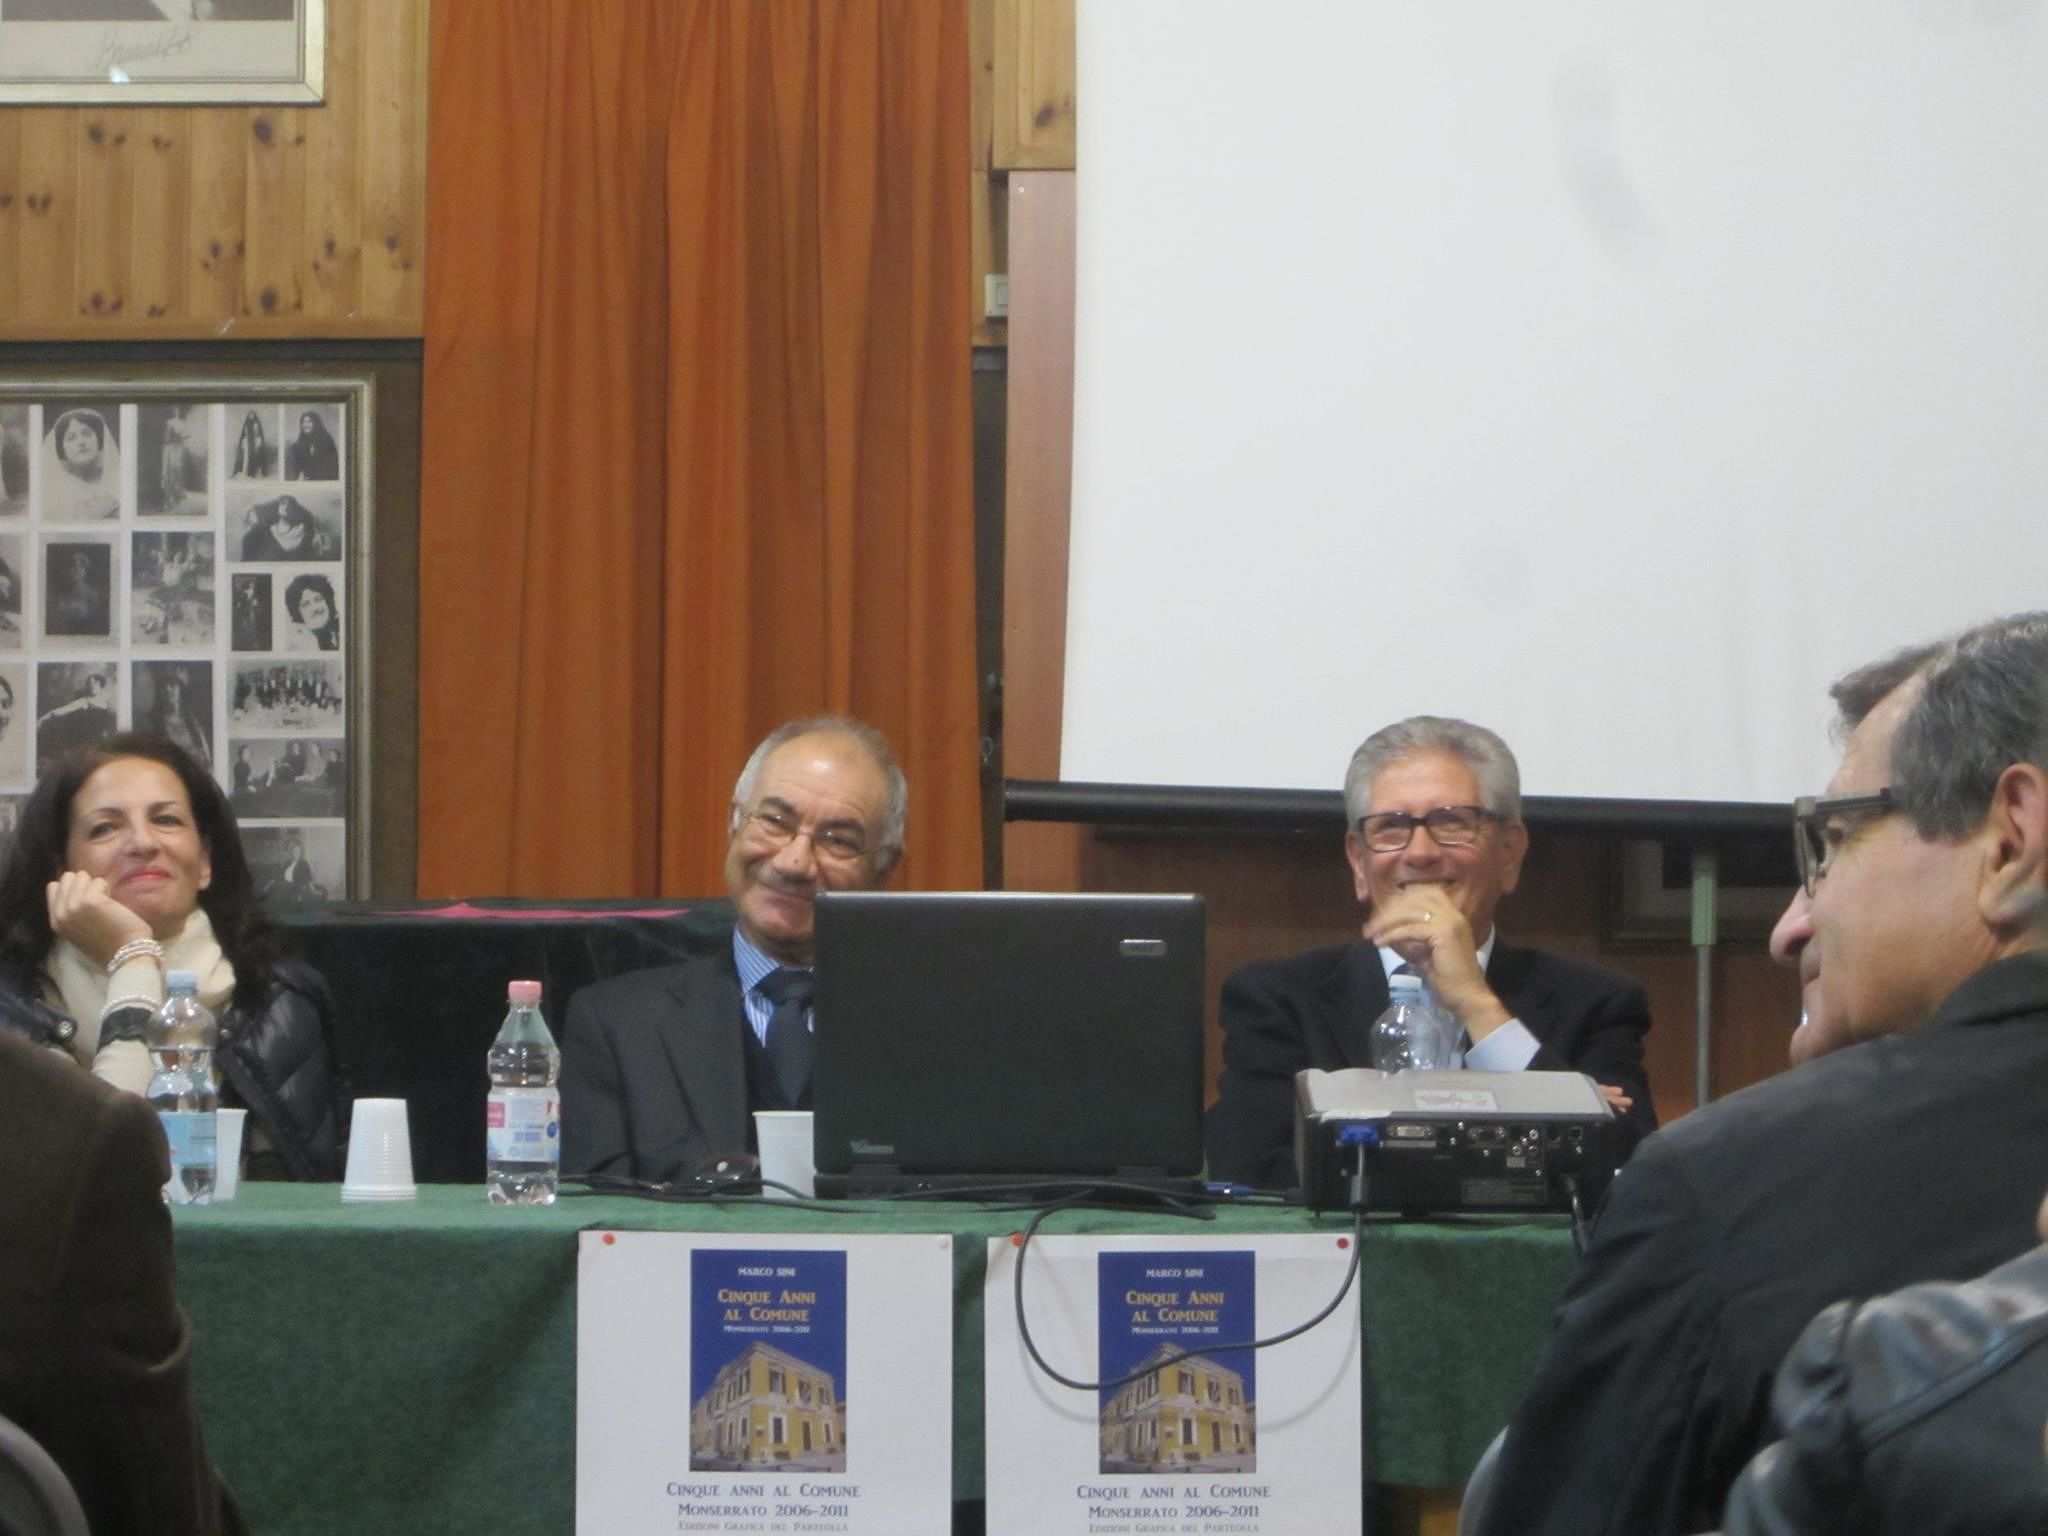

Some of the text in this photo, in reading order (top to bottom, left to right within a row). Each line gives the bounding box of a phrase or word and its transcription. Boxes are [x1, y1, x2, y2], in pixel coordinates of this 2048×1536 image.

[738, 1267, 773, 1277] MARCO
[1146, 1269, 1181, 1278] MARCO
[718, 1289, 816, 1305] CINQUE ANNI
[1126, 1290, 1224, 1307] CINQUE ANNI
[723, 1306, 809, 1322] AL COMUNE
[1132, 1308, 1218, 1323] AL COMUNE
[666, 1482, 860, 1498] CINQUE ANNI AL COMUNE
[1076, 1484, 1270, 1500] CINQUE ANNI AL COMUNE
[678, 1503, 767, 1517] MONSERRATO
[1088, 1506, 1178, 1518] MONSERRATO
